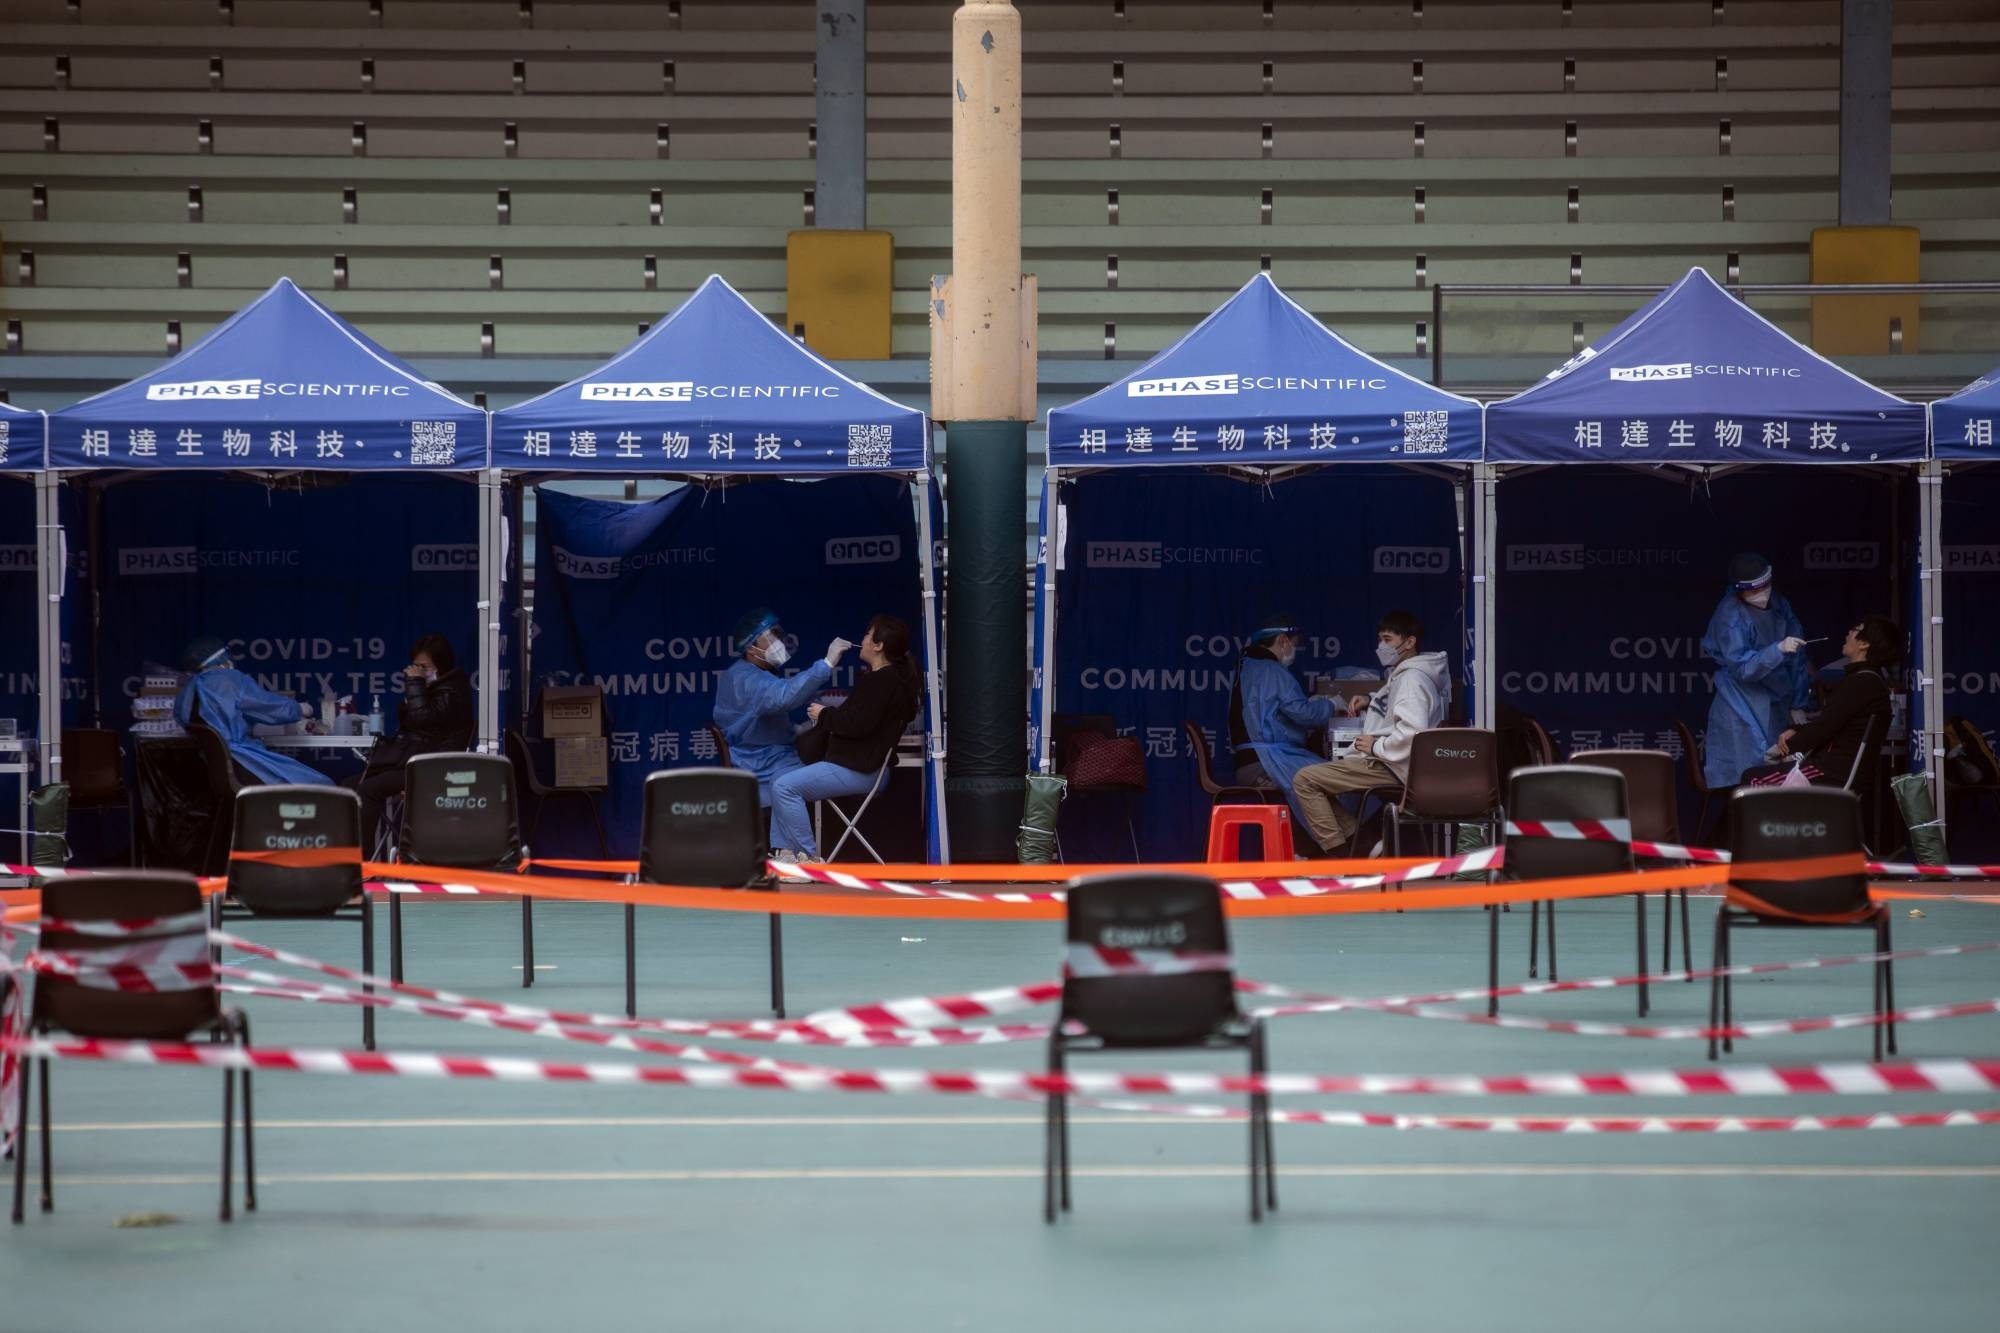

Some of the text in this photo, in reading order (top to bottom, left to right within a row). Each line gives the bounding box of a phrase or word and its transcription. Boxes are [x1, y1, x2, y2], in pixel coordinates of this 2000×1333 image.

[262, 382, 410, 397] SCIENTIFIC
[694, 385, 840, 399] SCIENTIFIC
[1240, 376, 1387, 391] SCIENTIFIC
[81, 427, 345, 459] 相達生物科技
[1079, 422, 1337, 454] 相達生物科技
[1574, 419, 1838, 451] 相達生物科技
[523, 430, 782, 461] 相達生物科技
[226, 637, 386, 662] COVID-19
[1185, 635, 1341, 658] COV-19
[1501, 671, 1716, 694] COMMUNITY
[1434, 747, 1477, 760] CSWCC
[435, 796, 487, 809] CSWCC
[671, 800, 728, 815] CSWCC
[266, 835, 327, 849] CSWCC
